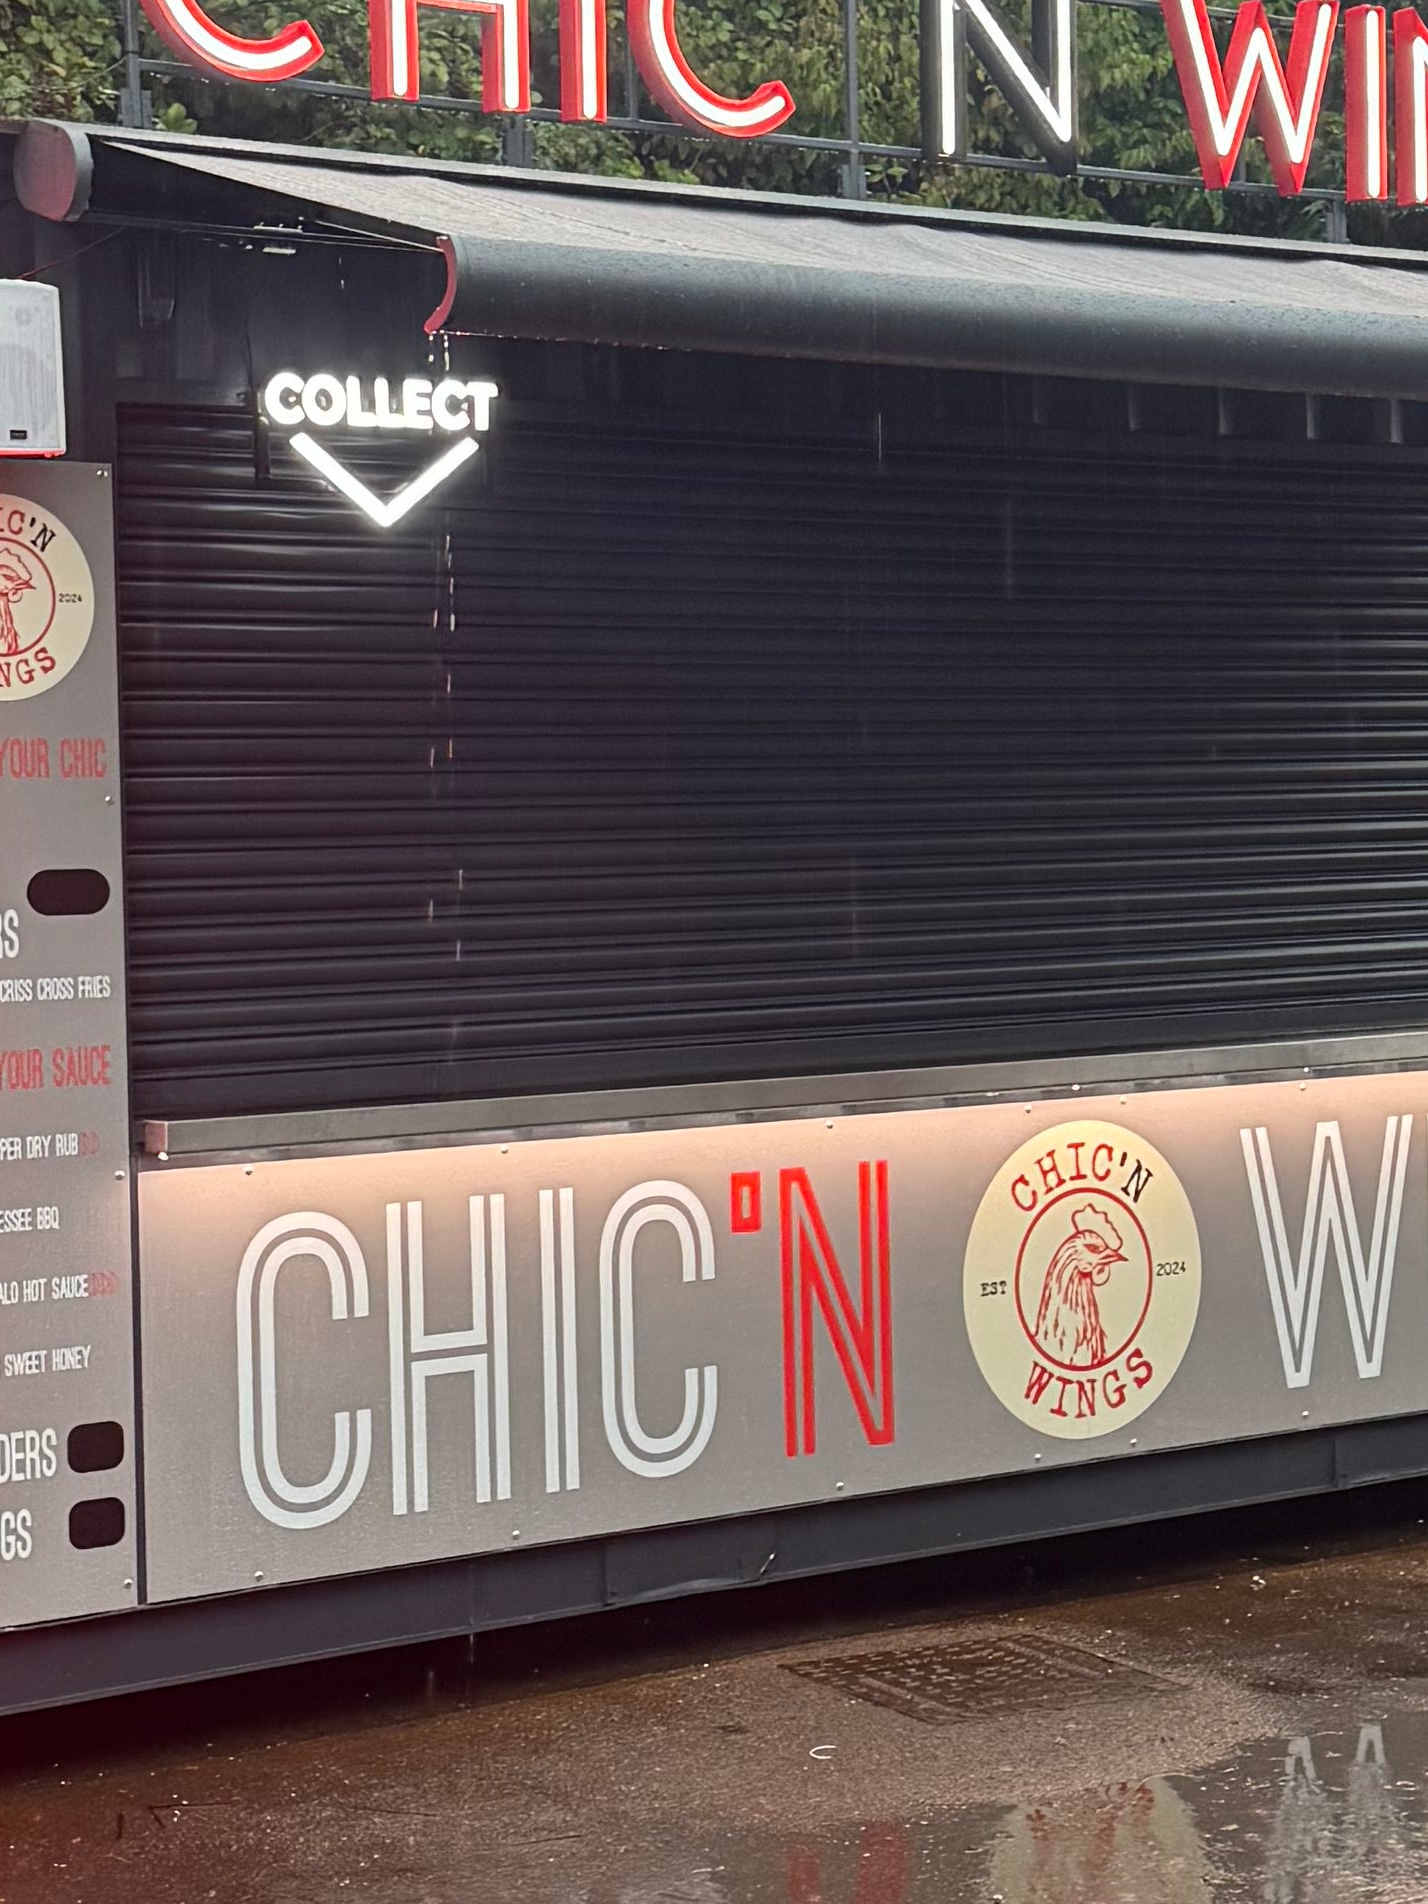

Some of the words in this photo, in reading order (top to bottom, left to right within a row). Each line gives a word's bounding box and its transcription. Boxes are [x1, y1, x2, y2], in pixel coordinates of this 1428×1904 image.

[264, 372, 498, 431] COLLECT
[60, 738, 106, 778] CHIC
[0, 979, 33, 1002] CRISS
[37, 976, 74, 1000] CROSS
[78, 975, 111, 999] FRIES
[52, 1045, 111, 1087] SAUCE
[26, 1135, 52, 1159] DRY
[56, 1133, 78, 1156] RUB
[1011, 1142, 1154, 1212] CHIC'N
[37, 1206, 60, 1230] BBQ
[1156, 1261, 1186, 1277] 2024
[23, 1278, 47, 1303] HOT
[52, 1274, 89, 1299] SAUCE
[980, 1281, 1007, 1297] EST
[235, 1159, 895, 1530] CHIC'N
[5, 1350, 47, 1376] SWEET
[52, 1345, 92, 1371] HONEY
[1024, 1347, 1153, 1419] WINGS
